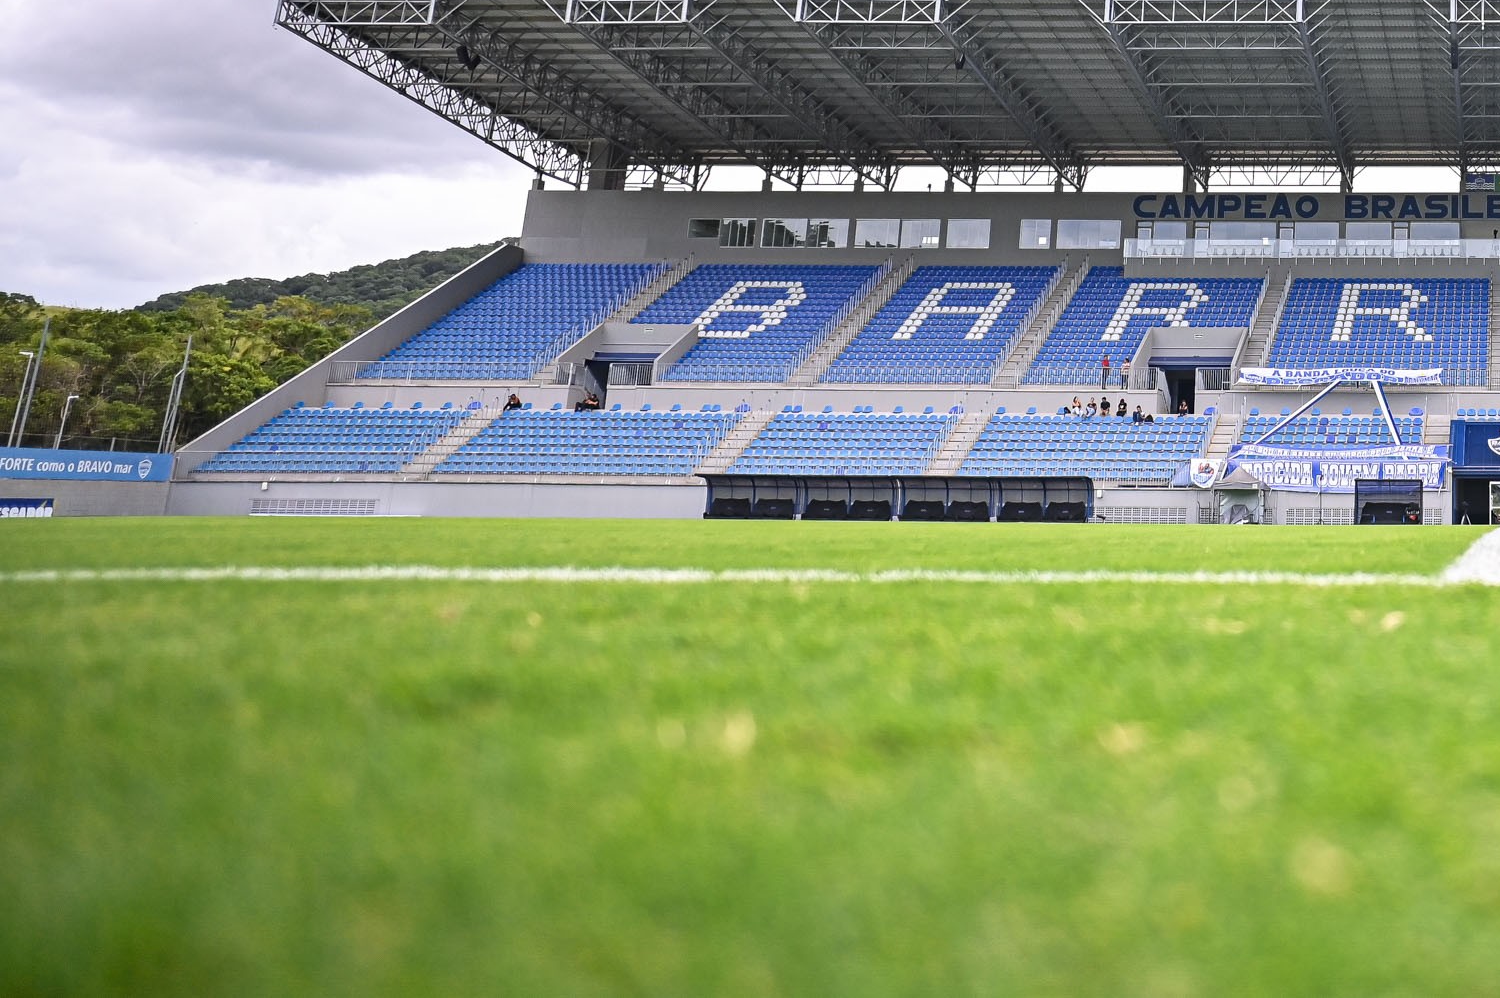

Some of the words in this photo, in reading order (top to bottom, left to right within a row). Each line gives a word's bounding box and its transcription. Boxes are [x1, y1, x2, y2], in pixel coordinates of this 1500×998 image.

[1286, 370, 1329, 378] BANDA
[0, 457, 34, 471] FORTE
[36, 461, 65, 472] como
[67, 462, 75, 472] o
[77, 460, 112, 473] BRAVO
[113, 463, 133, 474] mar
[1240, 462, 1313, 485] TORCIDA
